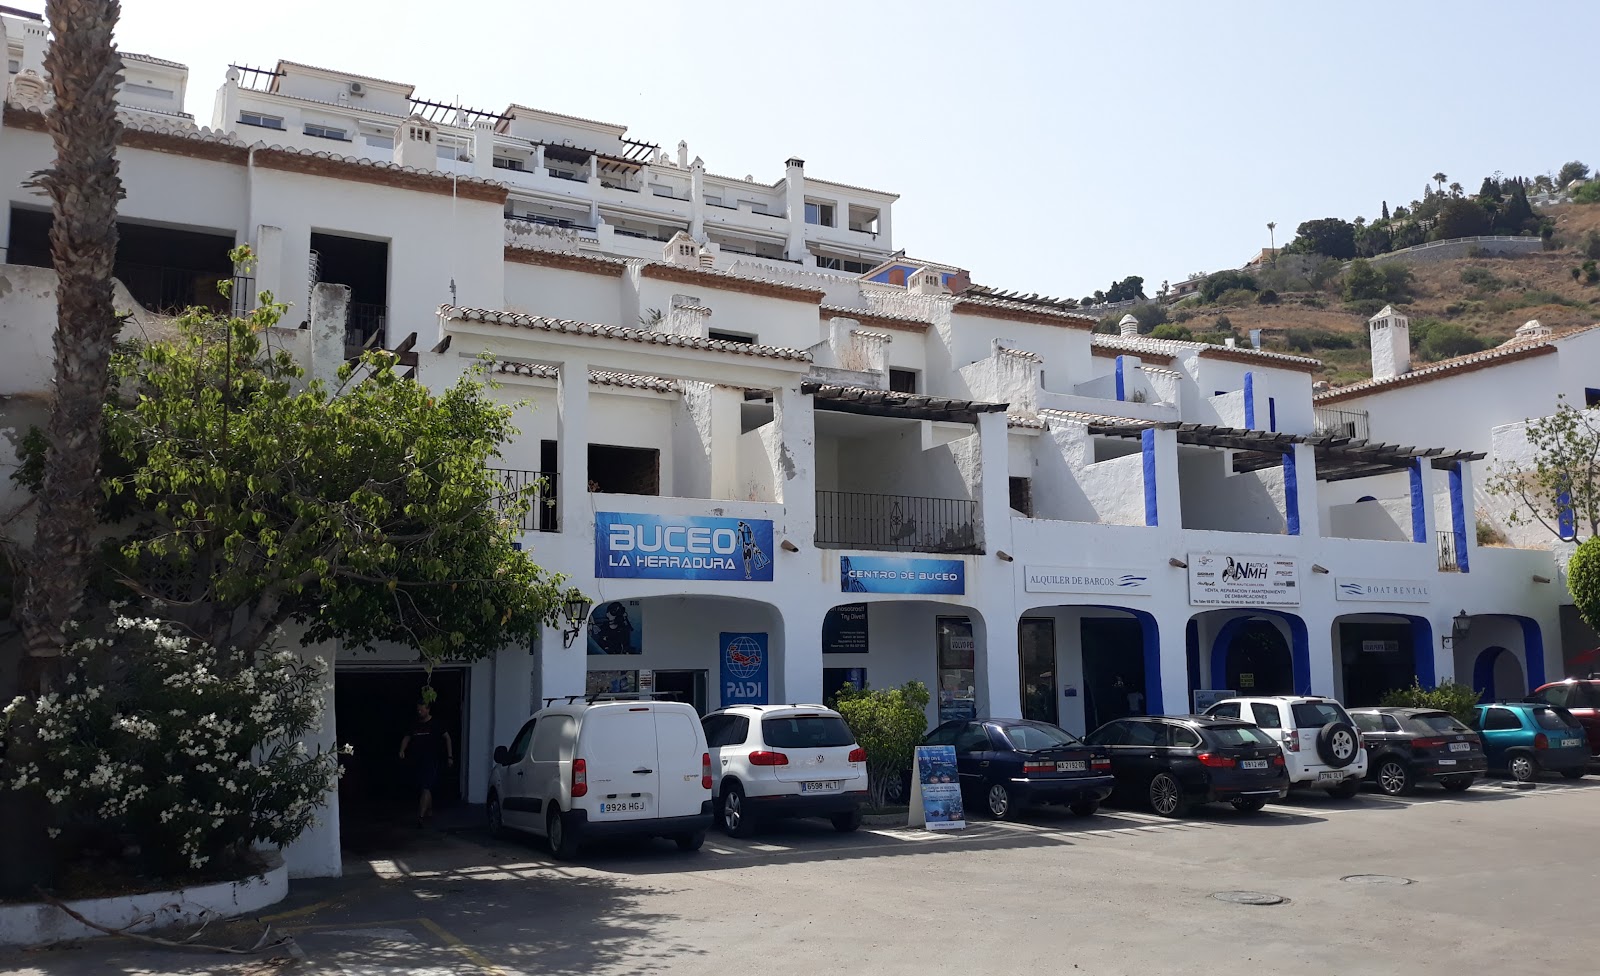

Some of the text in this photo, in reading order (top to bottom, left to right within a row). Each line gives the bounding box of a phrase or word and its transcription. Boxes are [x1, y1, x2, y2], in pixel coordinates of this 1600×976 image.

[609, 523, 736, 554] BUCEO
[609, 555, 736, 570] LA HERRADURA
[848, 570, 958, 581] CENTRO DE BUCEO
[1030, 575, 1115, 586] ALQUILER DE BARCOS
[1367, 585, 1428, 595] BOAT RENTAL
[841, 613, 850, 621] Try
[952, 641, 967, 649] VOLVO
[726, 681, 762, 698] PADI
[825, 781, 837, 789] HLT
[605, 802, 645, 812] 9928 HGJ
